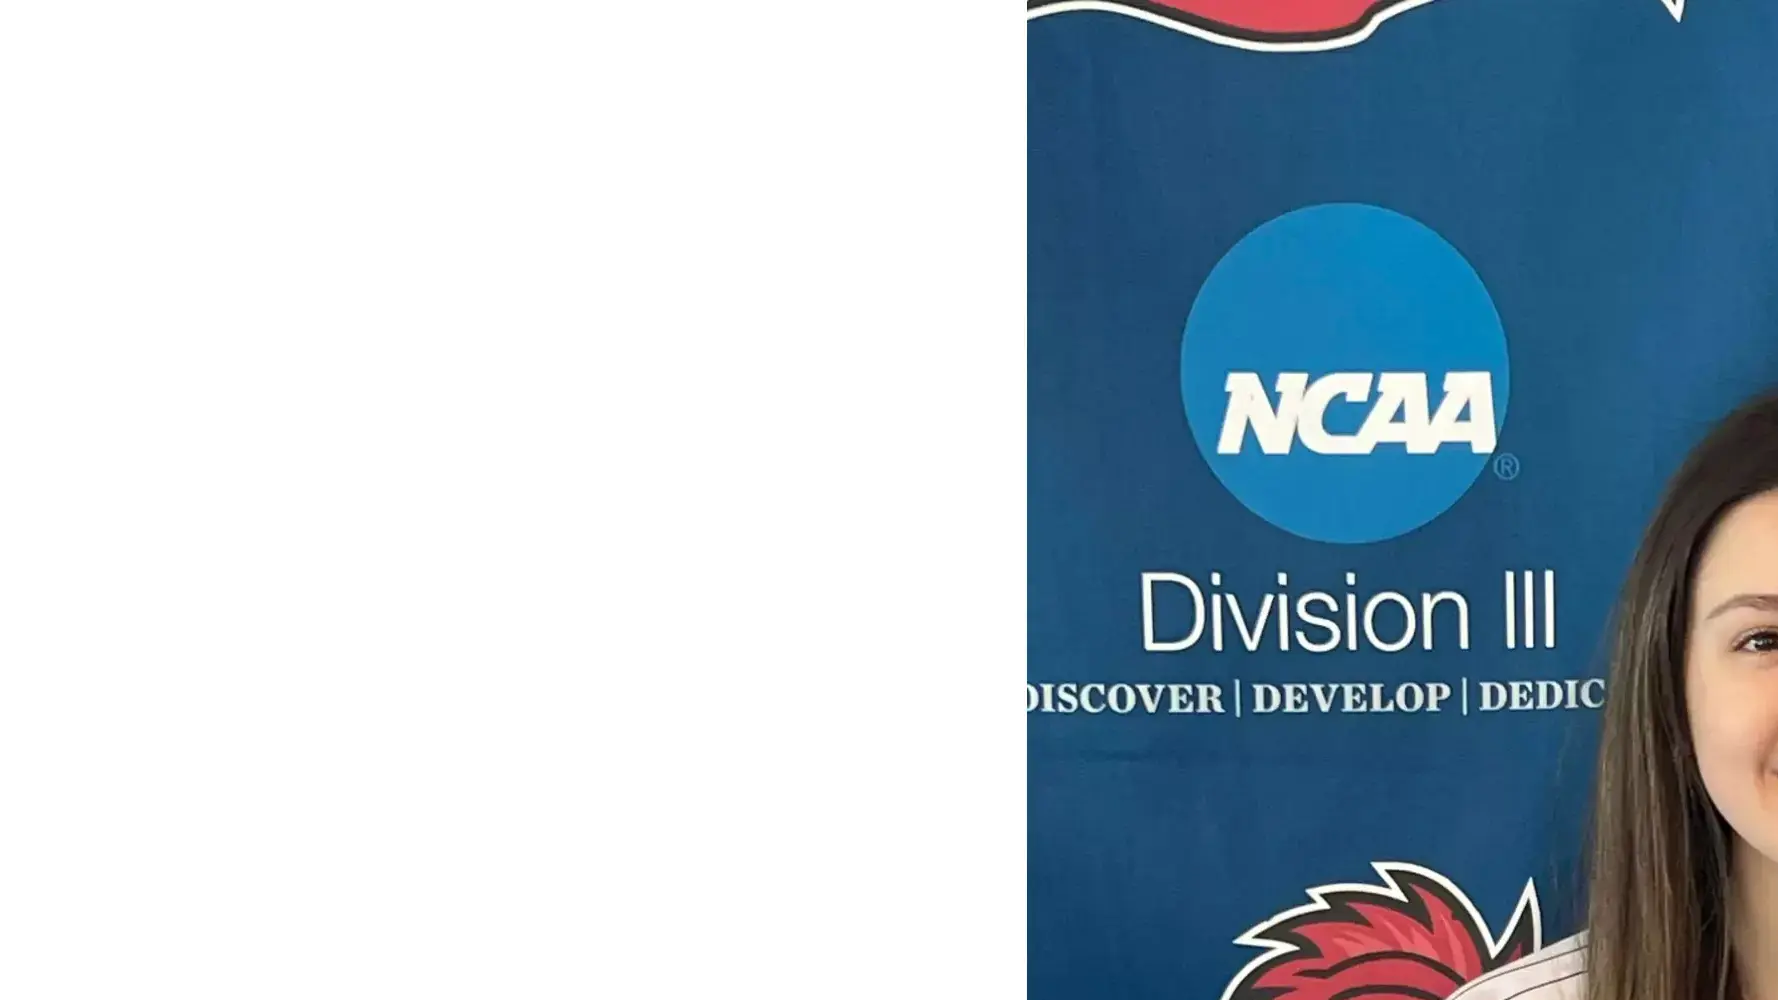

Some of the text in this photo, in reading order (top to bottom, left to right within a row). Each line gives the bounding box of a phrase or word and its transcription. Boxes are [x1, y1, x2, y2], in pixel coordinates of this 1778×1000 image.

[1217, 371, 1498, 455] NCAA
[1140, 569, 1557, 653] Division III
[1252, 682, 1453, 715] DEVELOP
[1479, 678, 1607, 712] DEDIC
